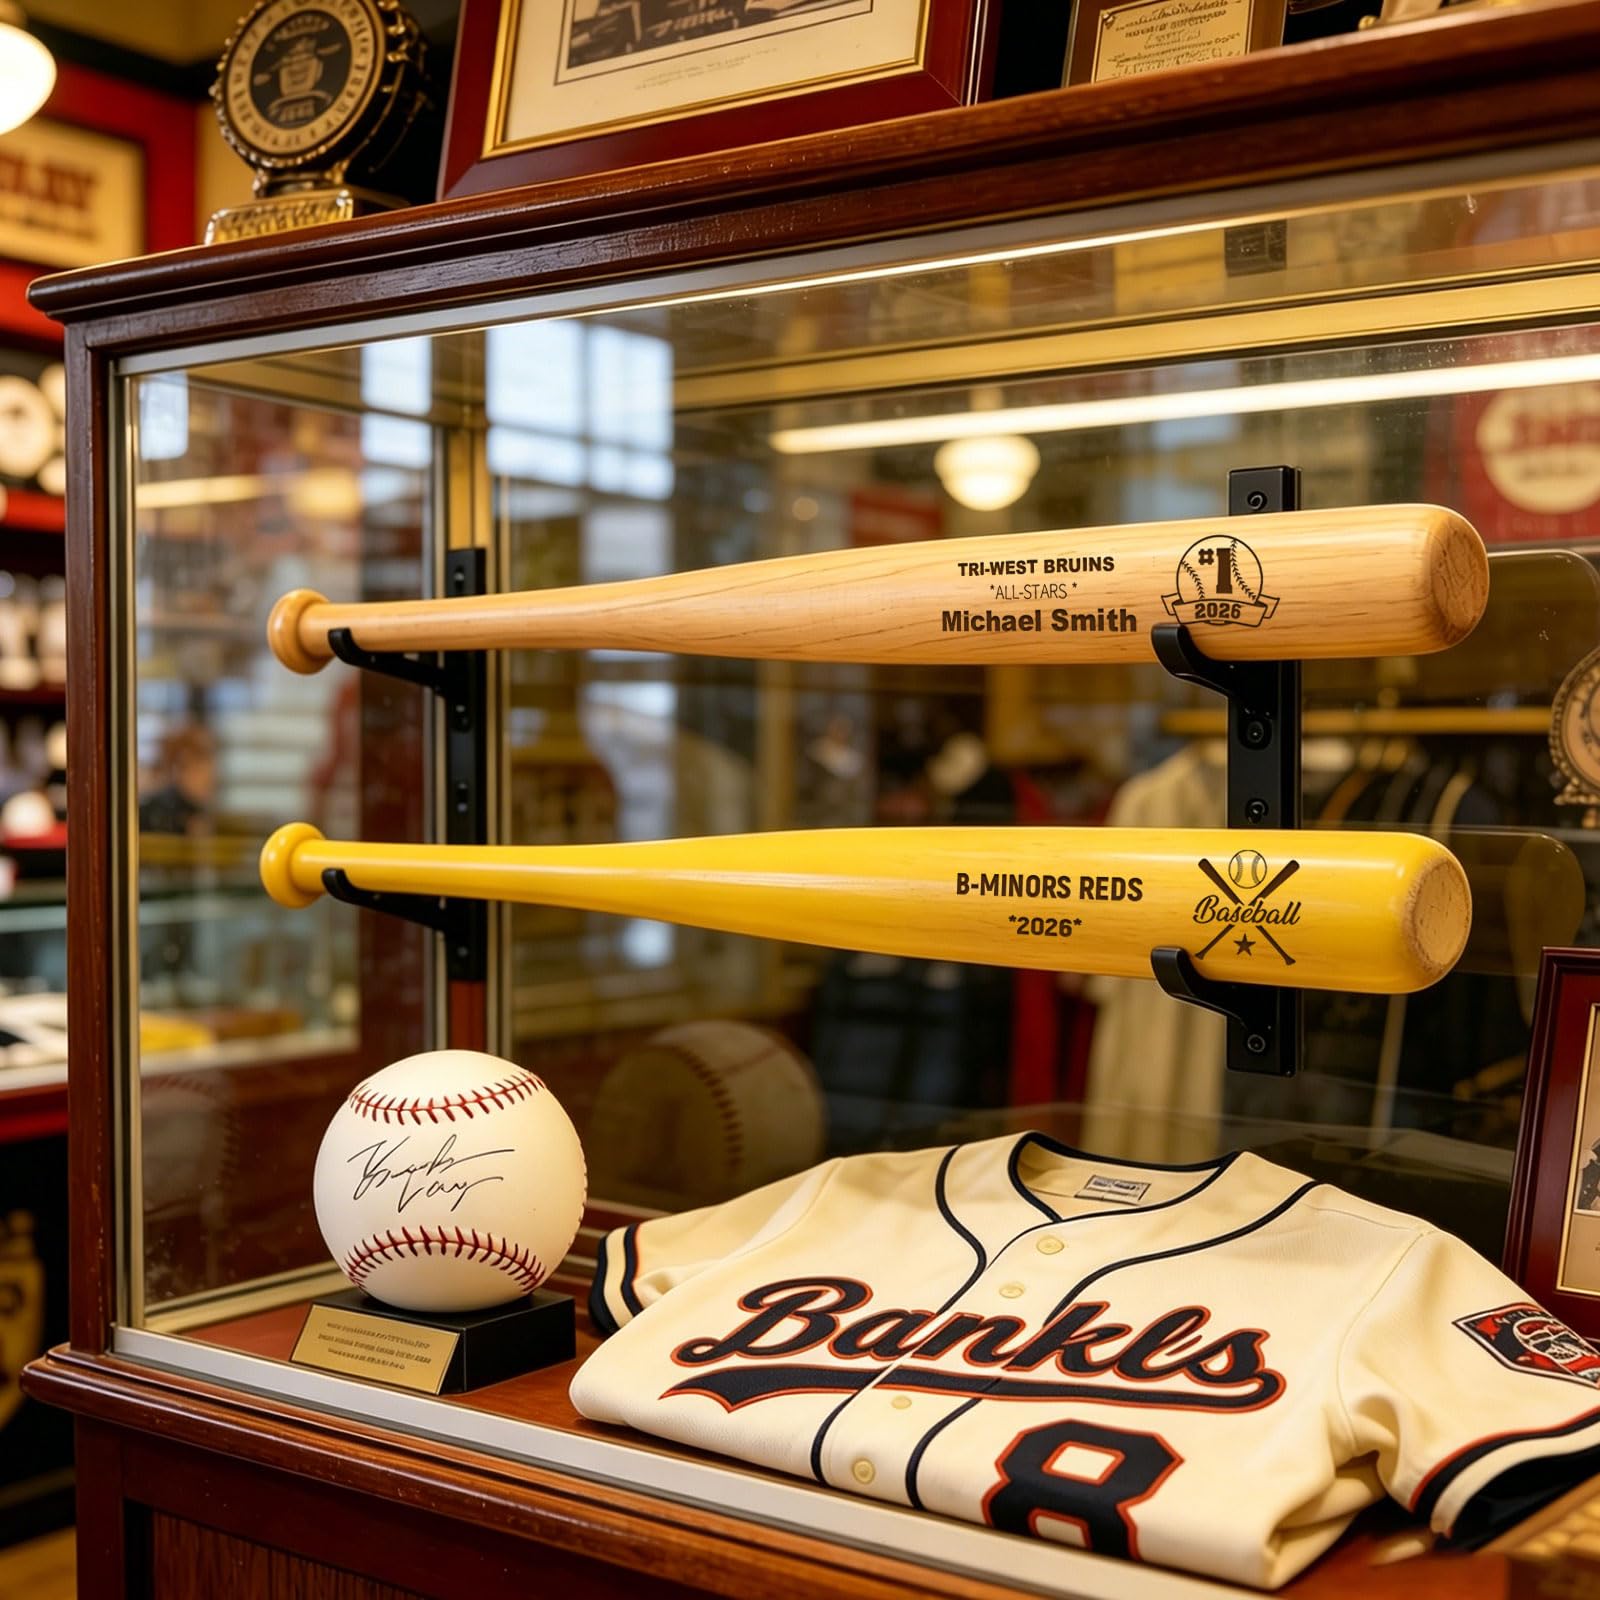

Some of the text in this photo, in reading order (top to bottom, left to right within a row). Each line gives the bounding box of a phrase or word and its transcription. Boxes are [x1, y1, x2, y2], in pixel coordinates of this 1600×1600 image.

[957, 556, 1115, 577] TRI-WEST BRUINS
[1198, 547, 1233, 594] #1
[941, 607, 1138, 633] Michael Smith
[1194, 602, 1242, 619] 2026
[956, 872, 1143, 902] B-MINORS REDS
[1192, 894, 1302, 925] Baseball
[981, 1418, 1185, 1560] 8
